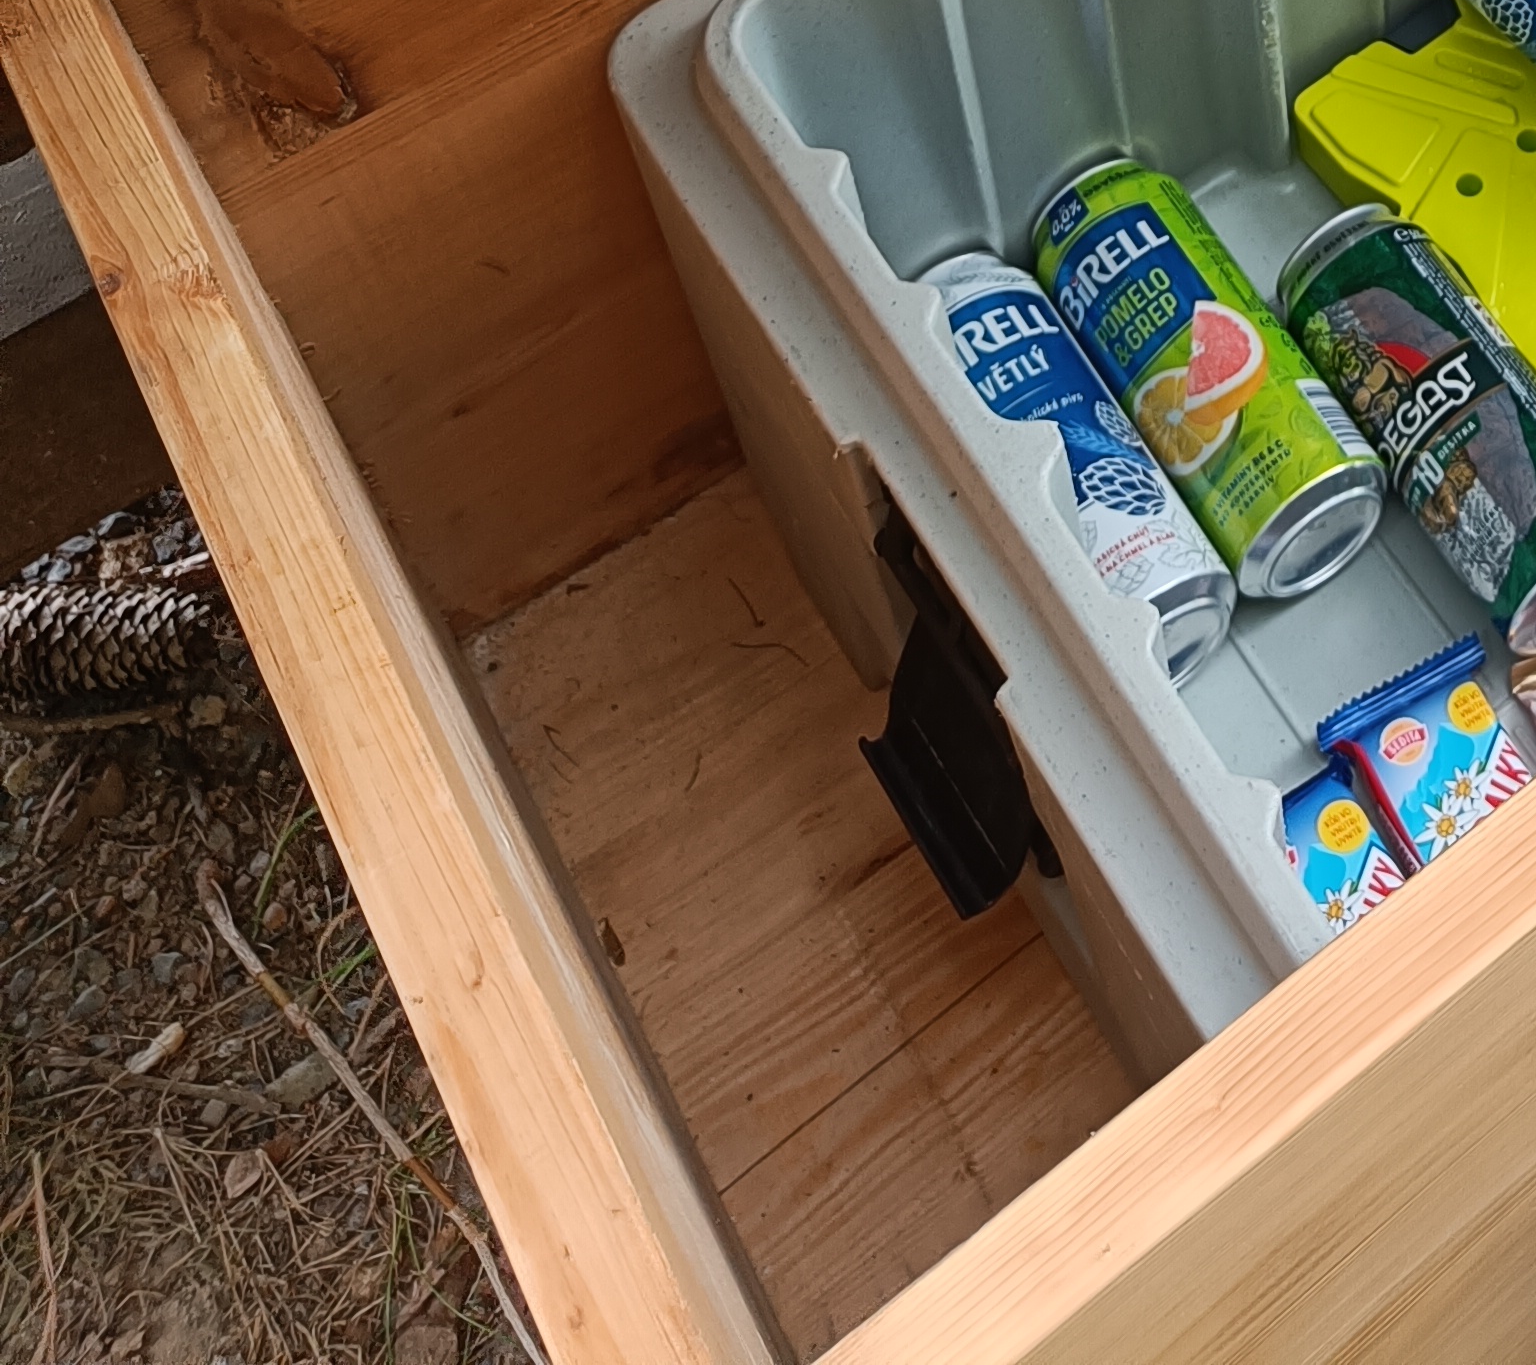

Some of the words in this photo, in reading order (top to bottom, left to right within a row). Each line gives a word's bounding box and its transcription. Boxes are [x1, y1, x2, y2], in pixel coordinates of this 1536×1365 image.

[1095, 266, 1171, 351] POMELO
[1124, 294, 1179, 355] GREP
[976, 344, 1051, 402] VĚTLÝ
[1116, 343, 1133, 367] &
